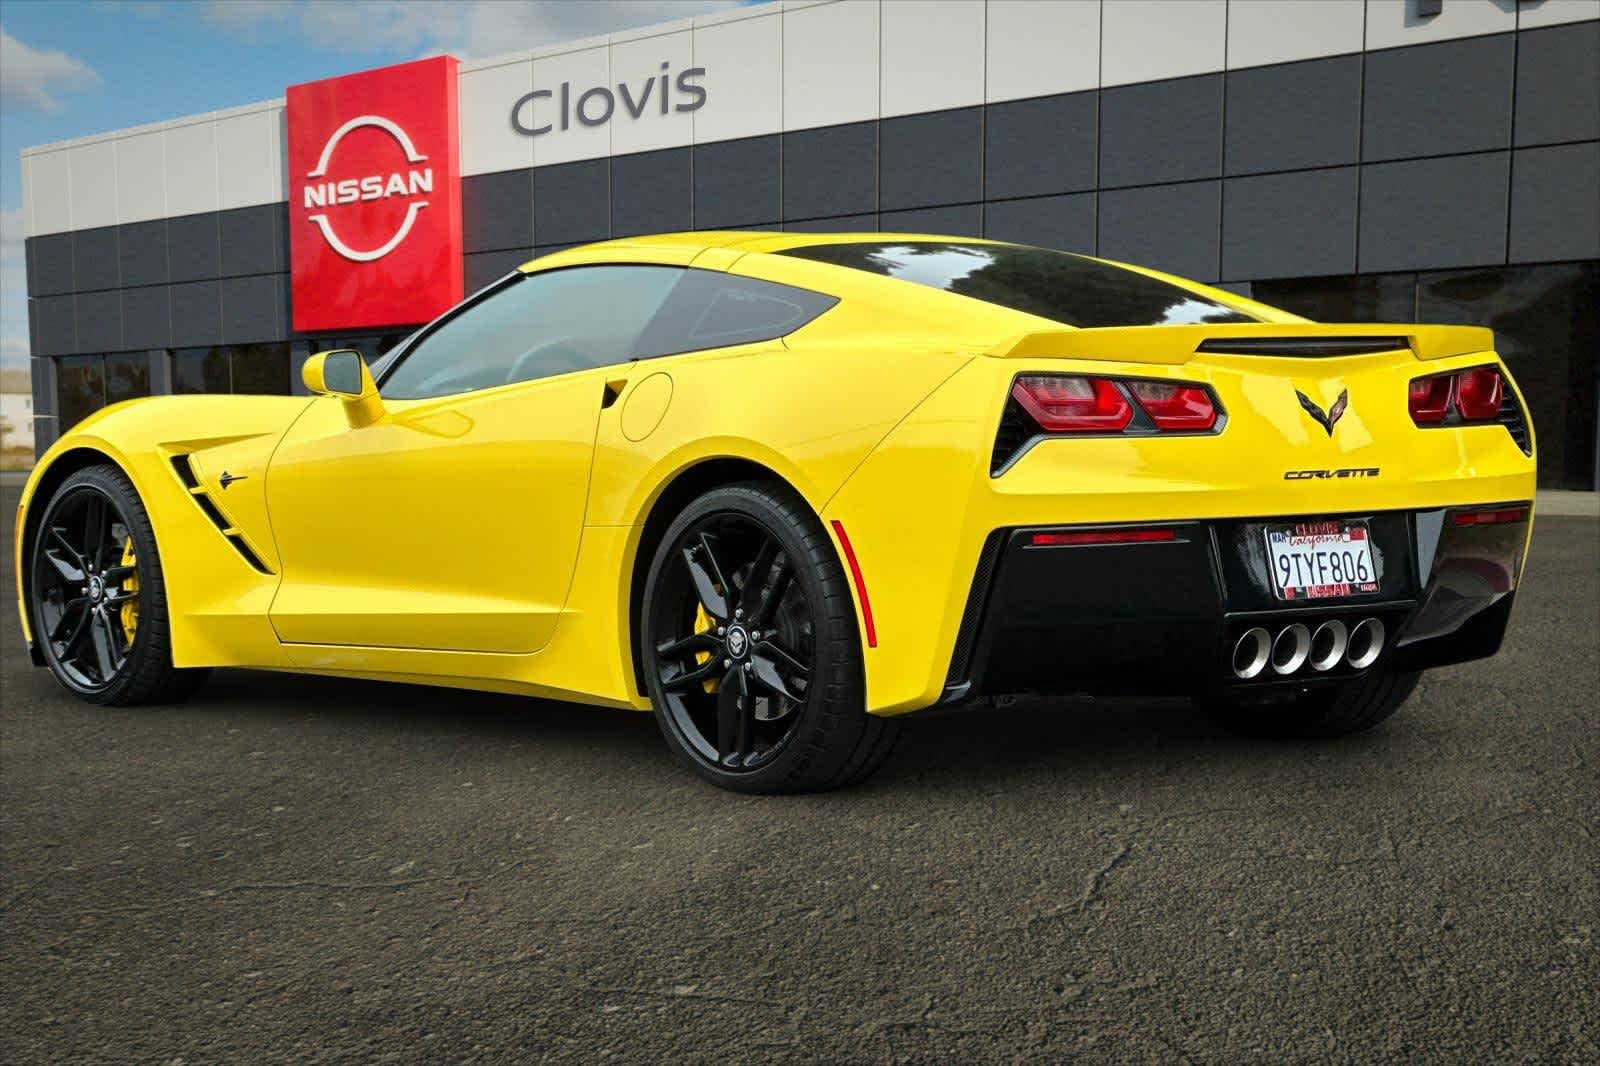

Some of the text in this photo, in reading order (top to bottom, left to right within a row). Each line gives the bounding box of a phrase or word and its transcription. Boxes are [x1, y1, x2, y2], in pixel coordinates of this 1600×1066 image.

[511, 61, 707, 137] Clovis
[304, 168, 433, 209] NISSAN
[1284, 468, 1380, 480] CORVETTE
[1279, 550, 1369, 587] 9TYF806
